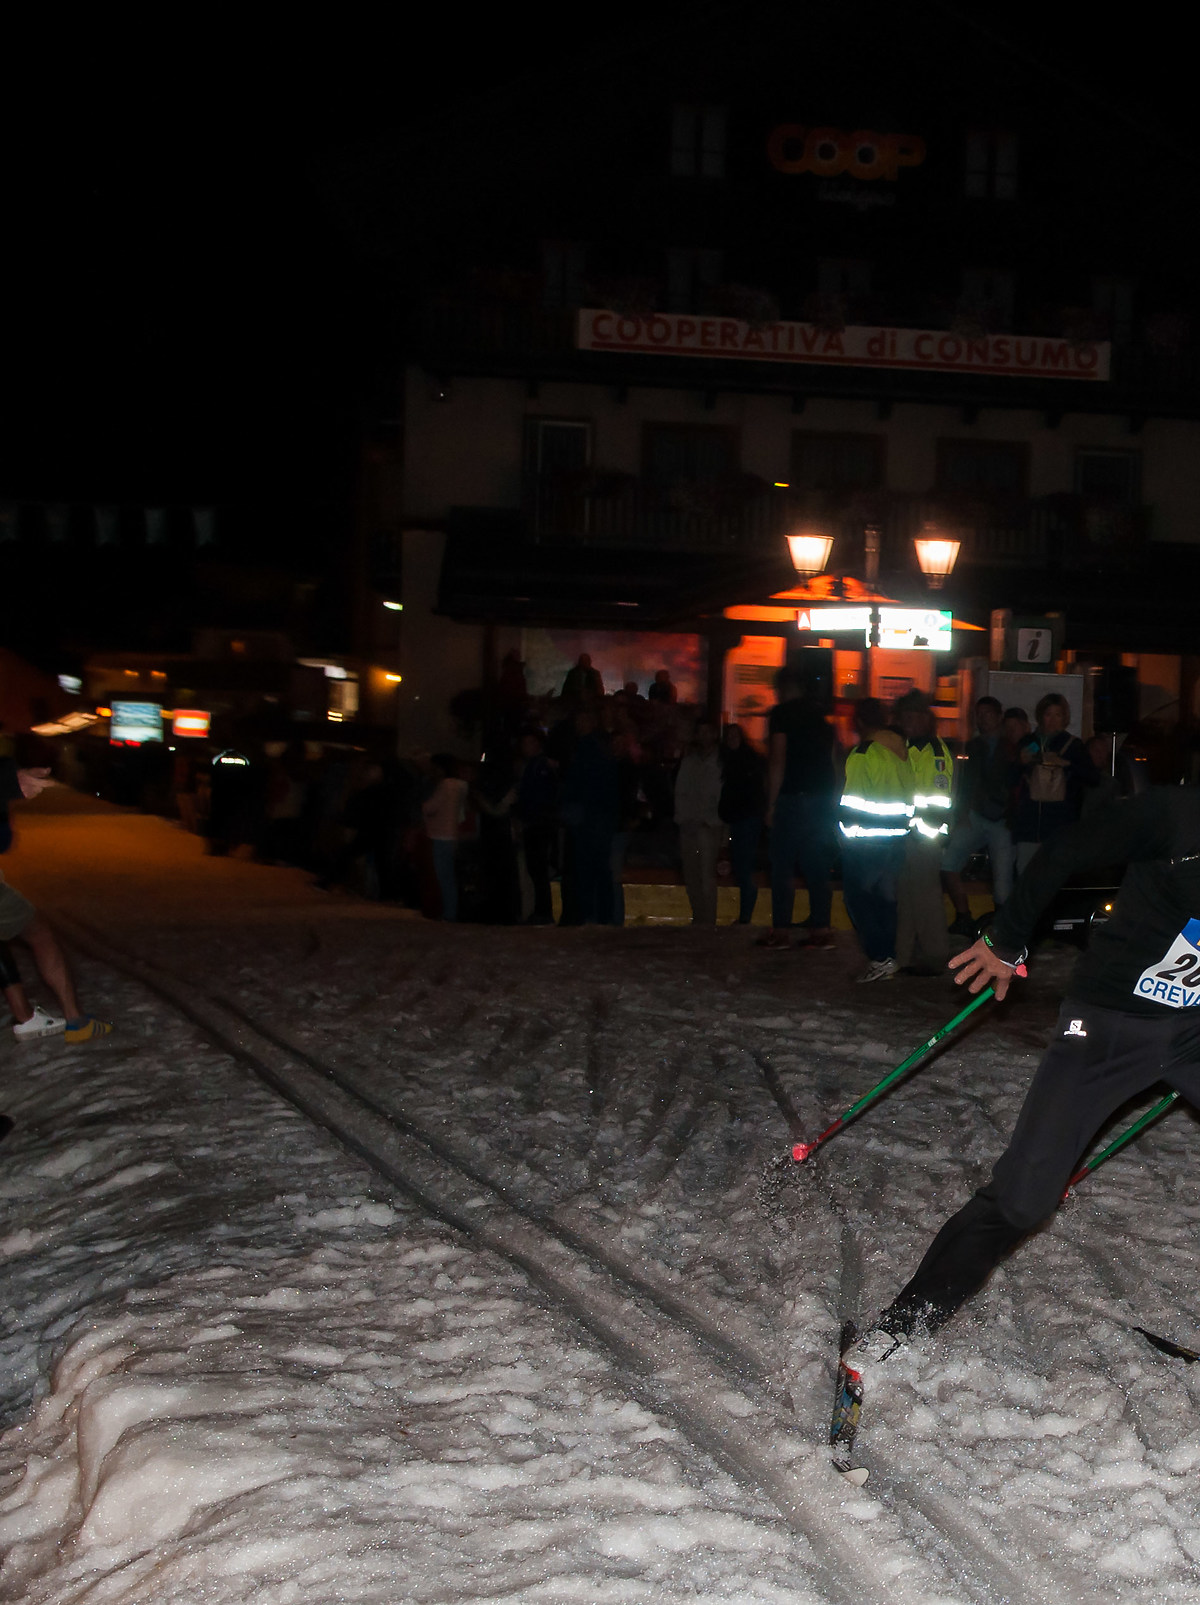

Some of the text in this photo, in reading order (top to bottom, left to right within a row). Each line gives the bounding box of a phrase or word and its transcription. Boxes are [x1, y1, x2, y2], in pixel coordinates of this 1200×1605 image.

[591, 314, 1098, 370] COOPERATIVA di CONSUMO
